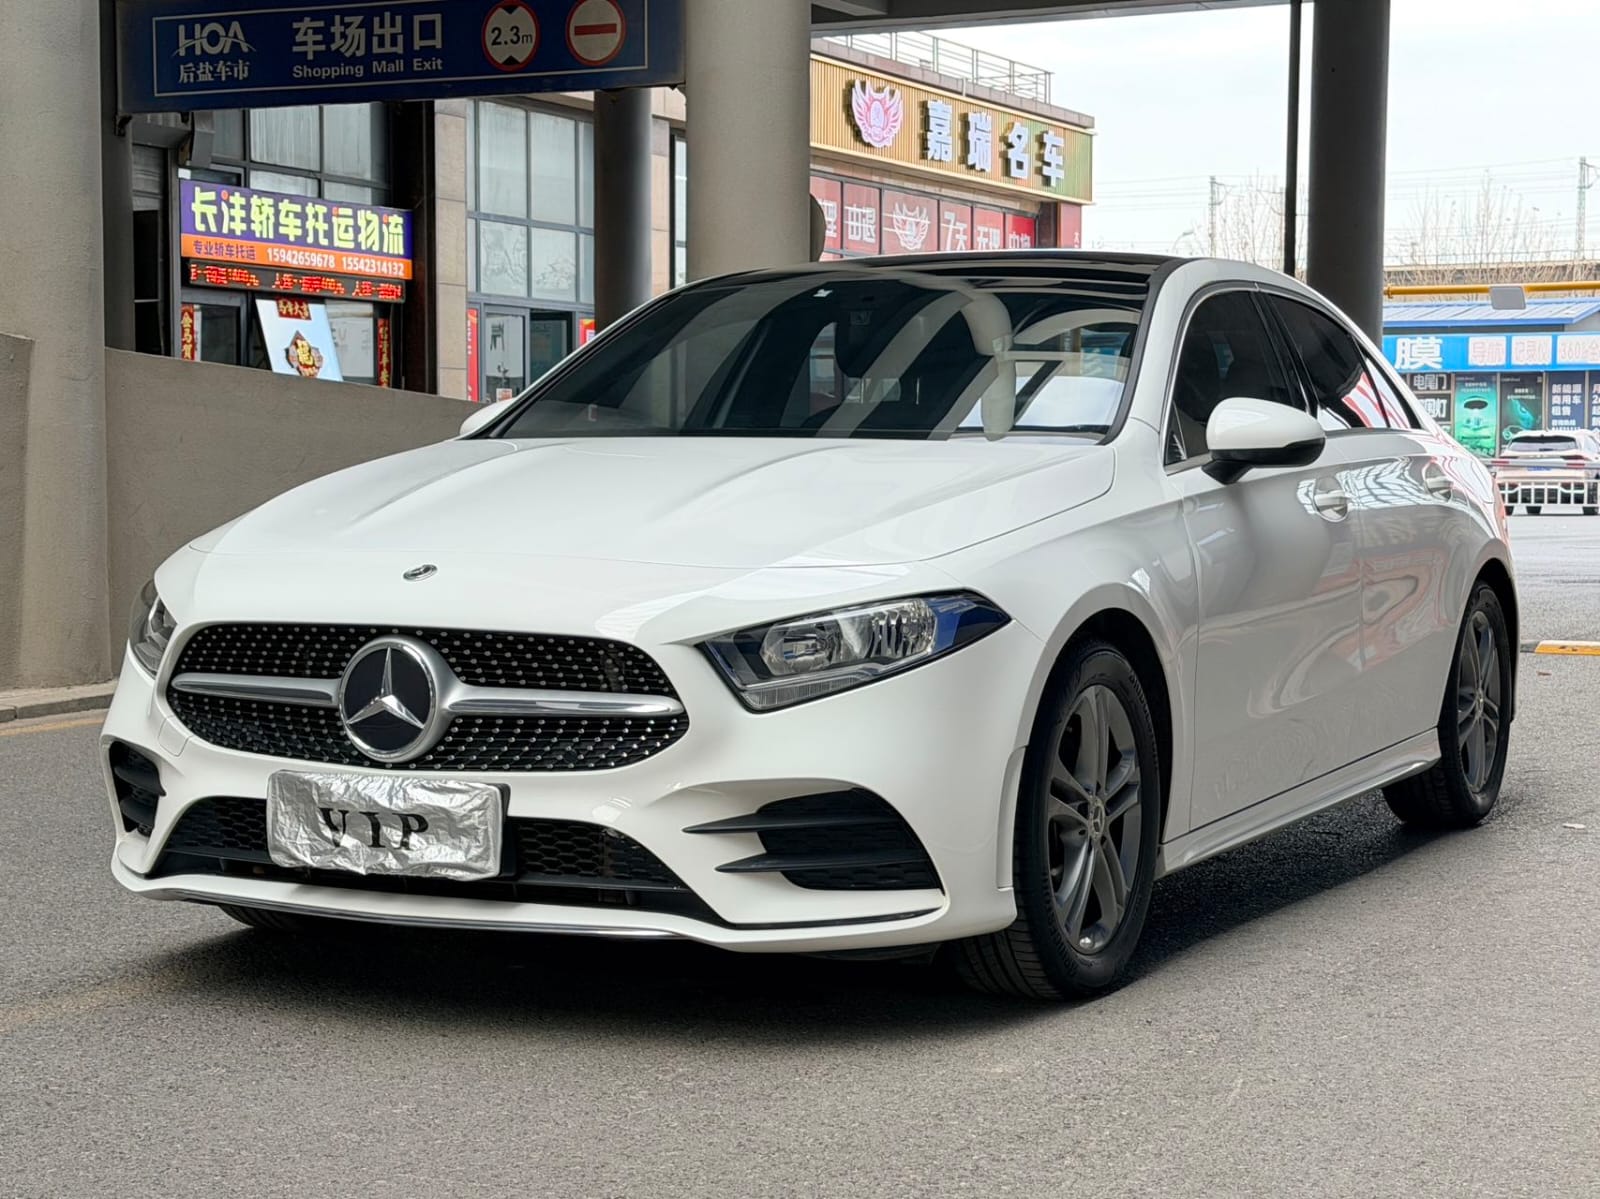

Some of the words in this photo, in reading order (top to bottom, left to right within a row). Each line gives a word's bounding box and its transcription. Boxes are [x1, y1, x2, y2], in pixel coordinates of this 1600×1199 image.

[178, 21, 250, 56] HOA
[292, 12, 443, 60] 车场出口
[491, 25, 533, 46] 2.3m
[179, 60, 250, 83] 后盐车市
[292, 63, 364, 79] Shopping
[372, 60, 404, 74] Mall
[413, 57, 443, 71] Exit
[927, 99, 1064, 188] 嘉瑞名车
[193, 240, 256, 261] 专业轿车托运
[266, 247, 336, 268] 15942659678
[341, 256, 405, 277] 15542314132
[1394, 336, 1443, 369] 膜
[318, 807, 429, 850] VIP
